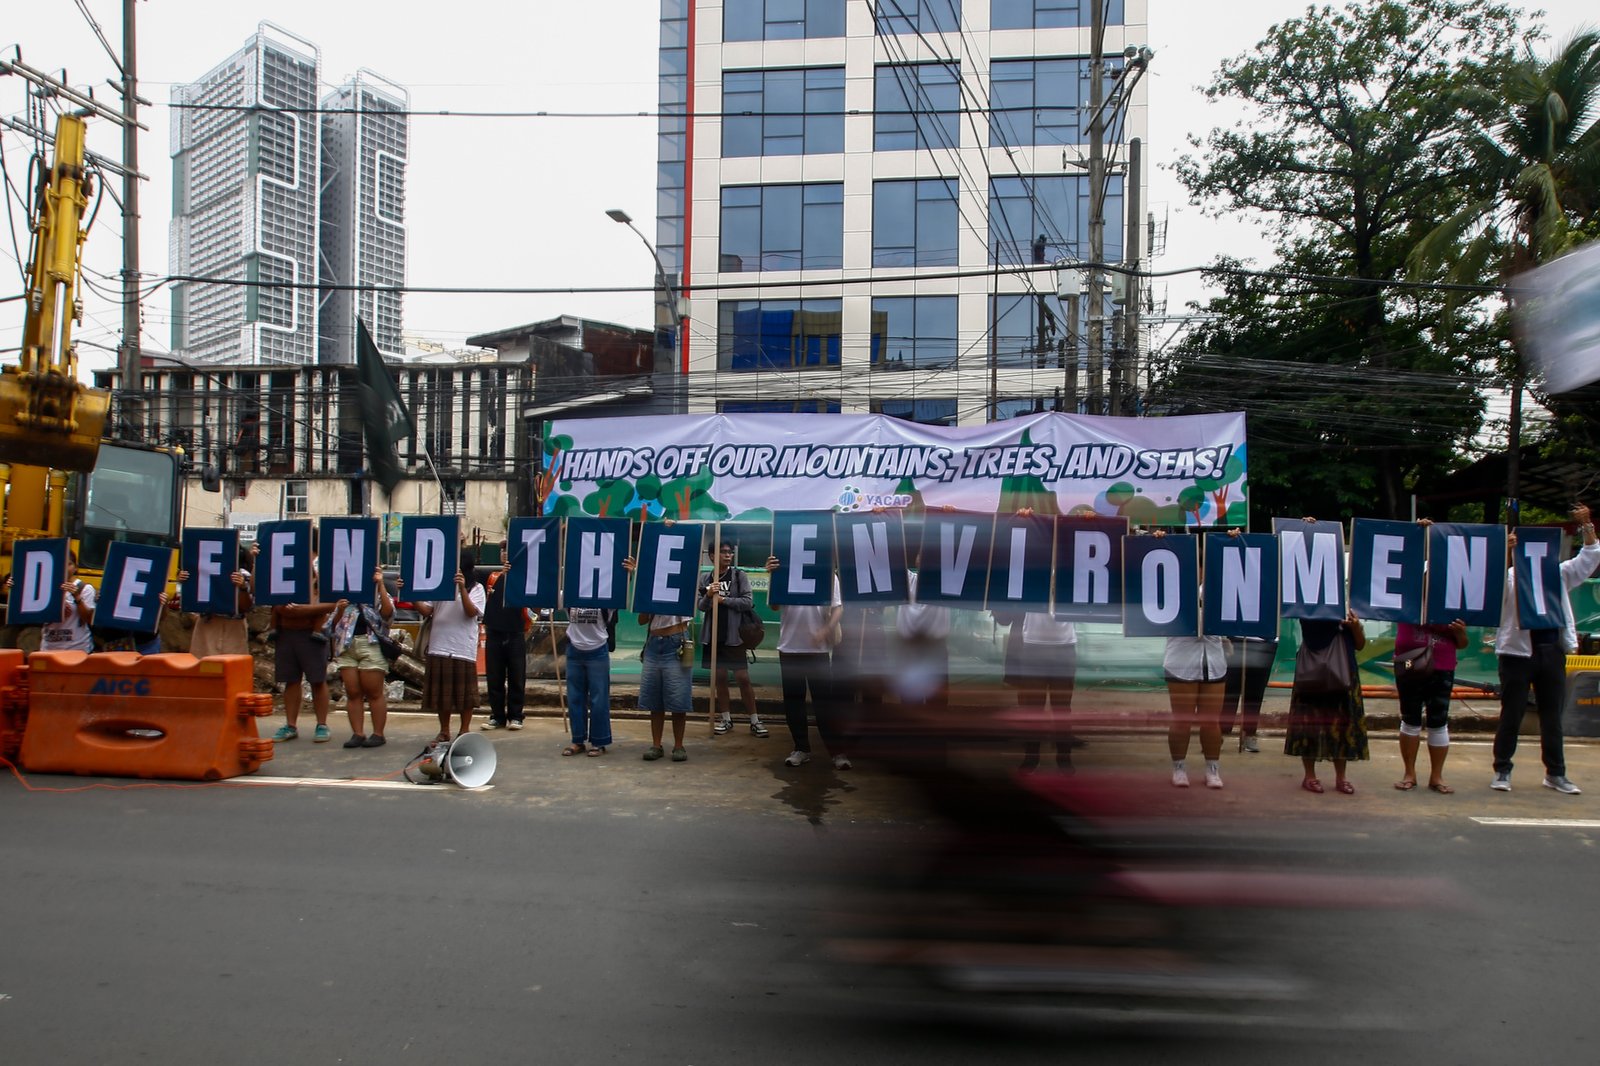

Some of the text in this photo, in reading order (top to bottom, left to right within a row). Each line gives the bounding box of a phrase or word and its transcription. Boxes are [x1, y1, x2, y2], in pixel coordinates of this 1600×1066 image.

[562, 444, 1231, 482] HANDS OFF OUR MOUNTAINS, TREES, AND SEAS!
[866, 494, 912, 506] YACAP
[20, 521, 1548, 624] DEFEND THE ENVIRONMENT
